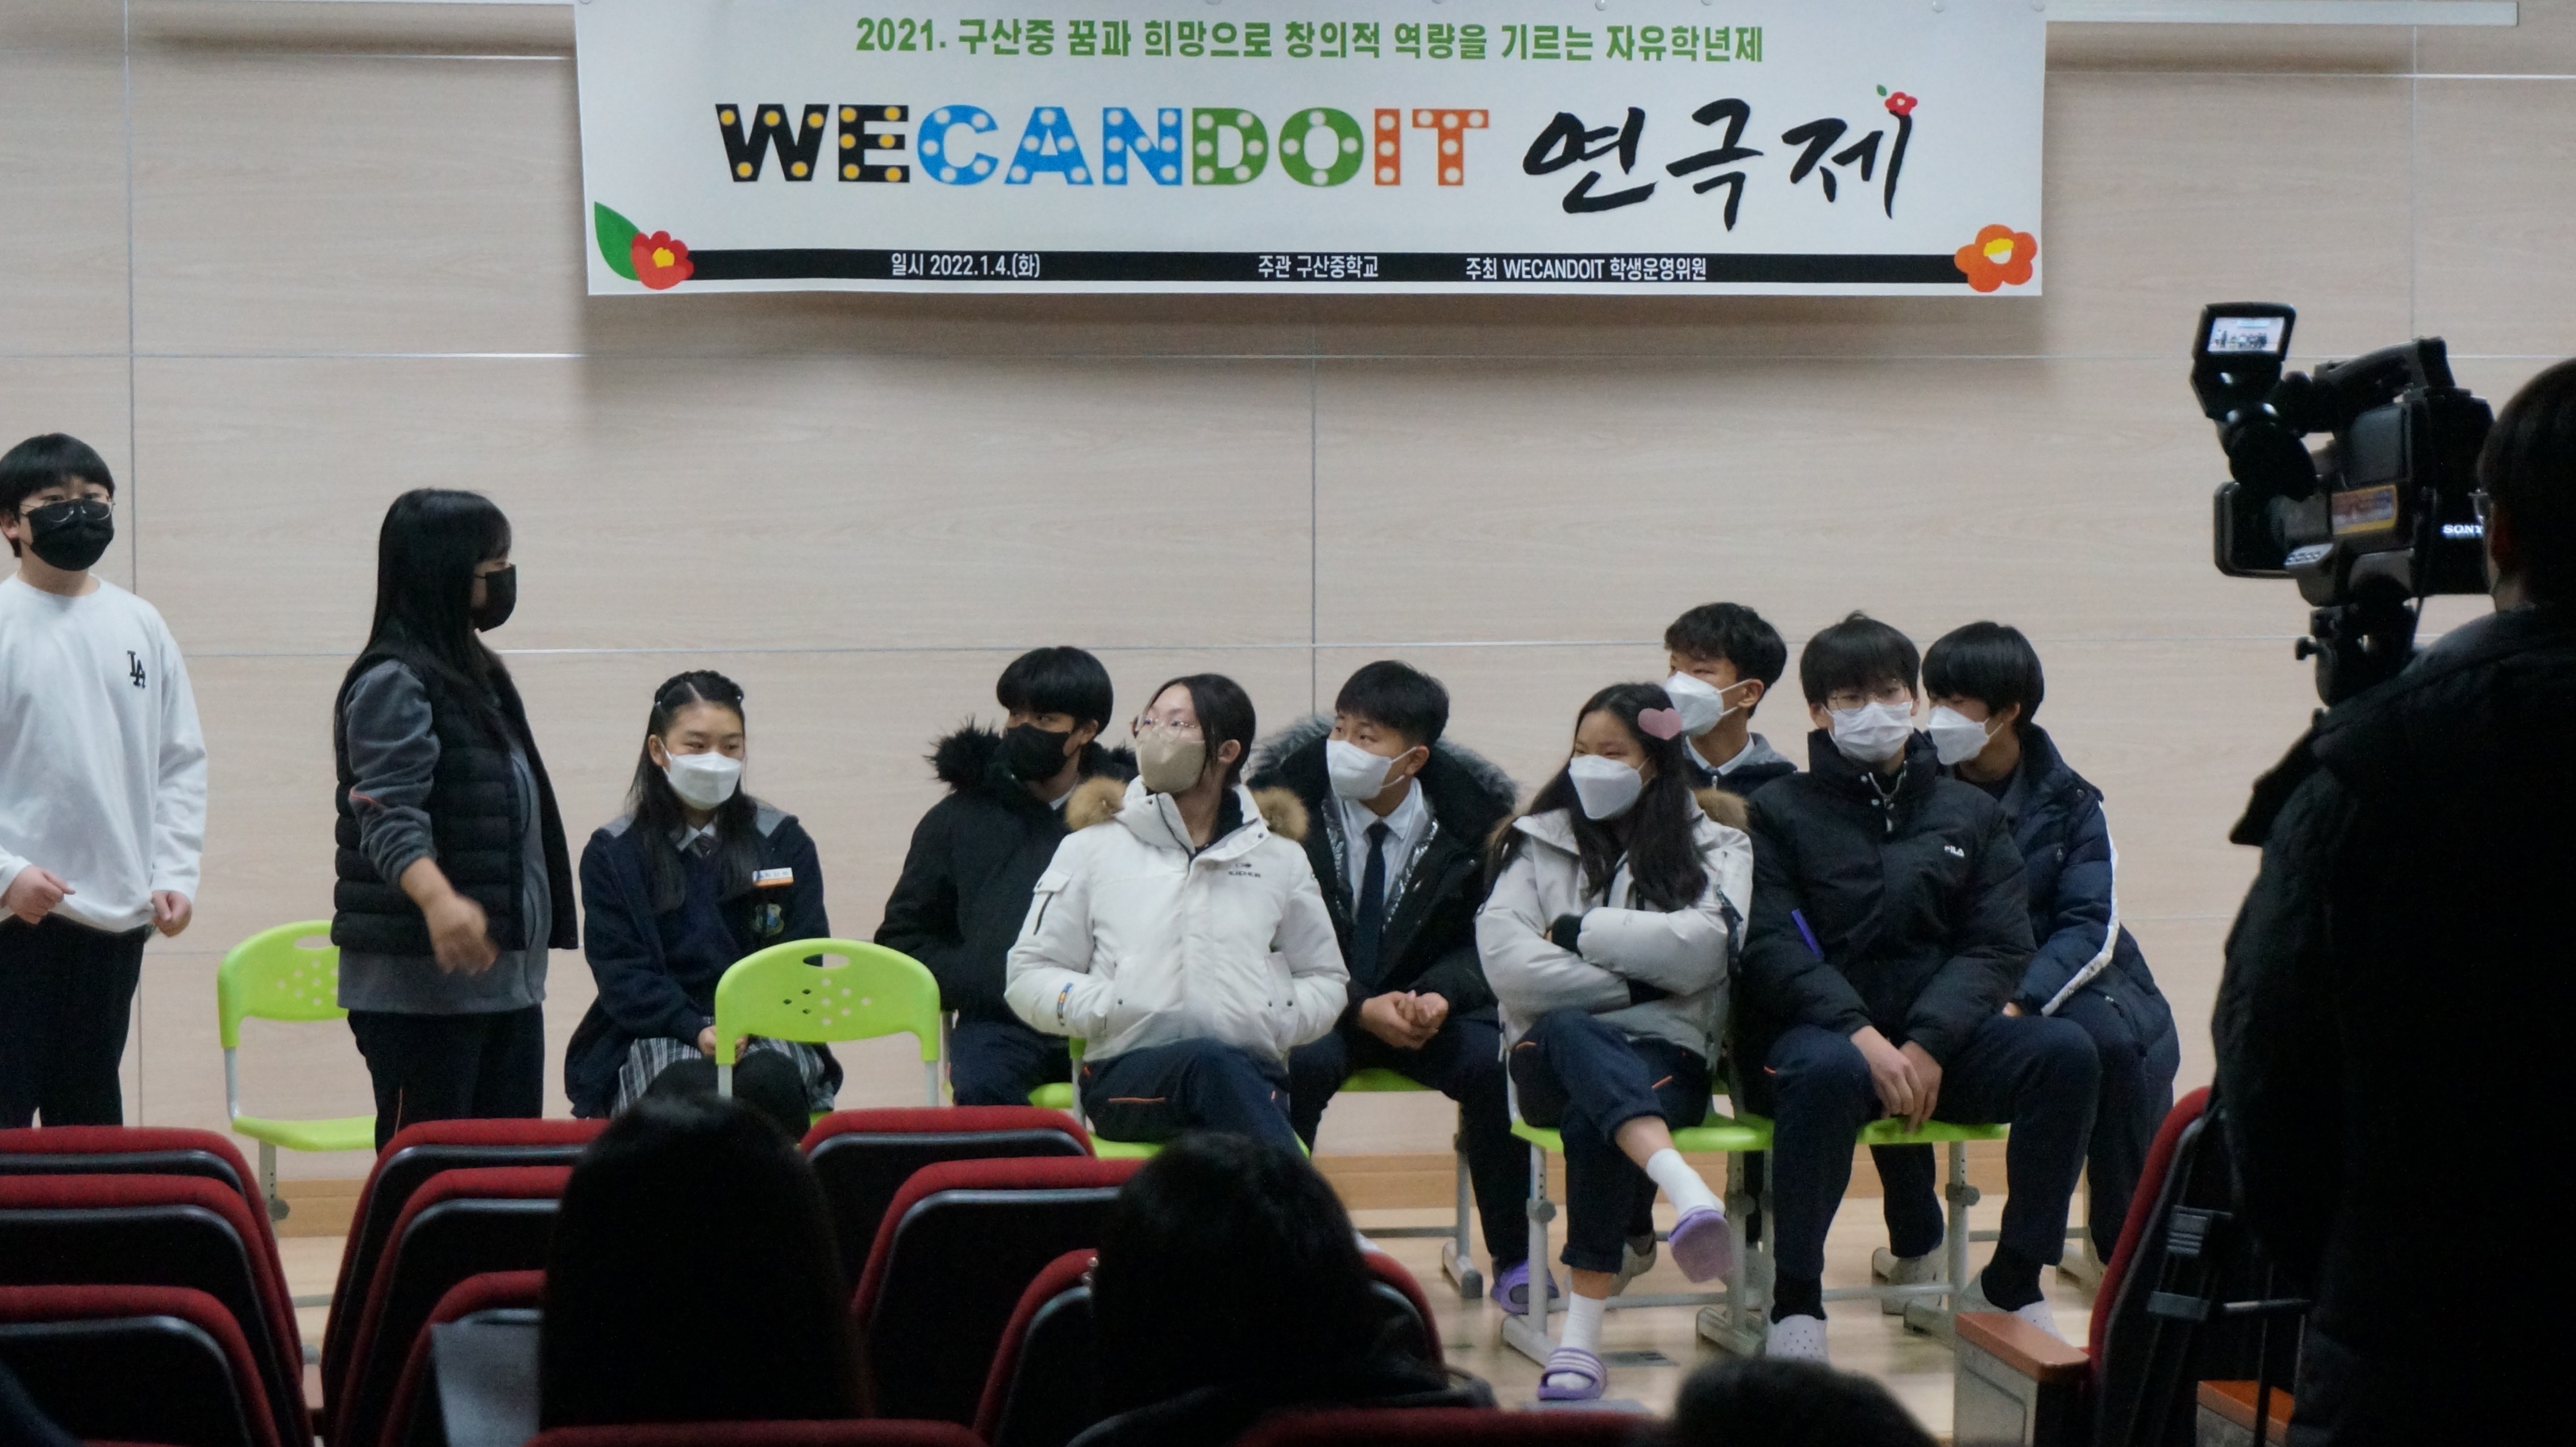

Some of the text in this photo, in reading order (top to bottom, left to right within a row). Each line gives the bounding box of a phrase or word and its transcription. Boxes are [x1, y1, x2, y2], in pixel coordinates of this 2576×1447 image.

[856, 18, 1763, 61] 2021. 구산중 꿈과 희망으로 창의적 역량을 기르는 자유학년제
[715, 98, 1911, 232] WECANDOIT 연극제
[891, 253, 1041, 278] 일시 2022.1.4.(화)
[1258, 255, 1379, 279] 주관 구산중학교
[1466, 257, 1707, 281] 주최 WECANDOIT 학생운영위원
[2443, 524, 2483, 534] SONY
[127, 650, 146, 689] LA
